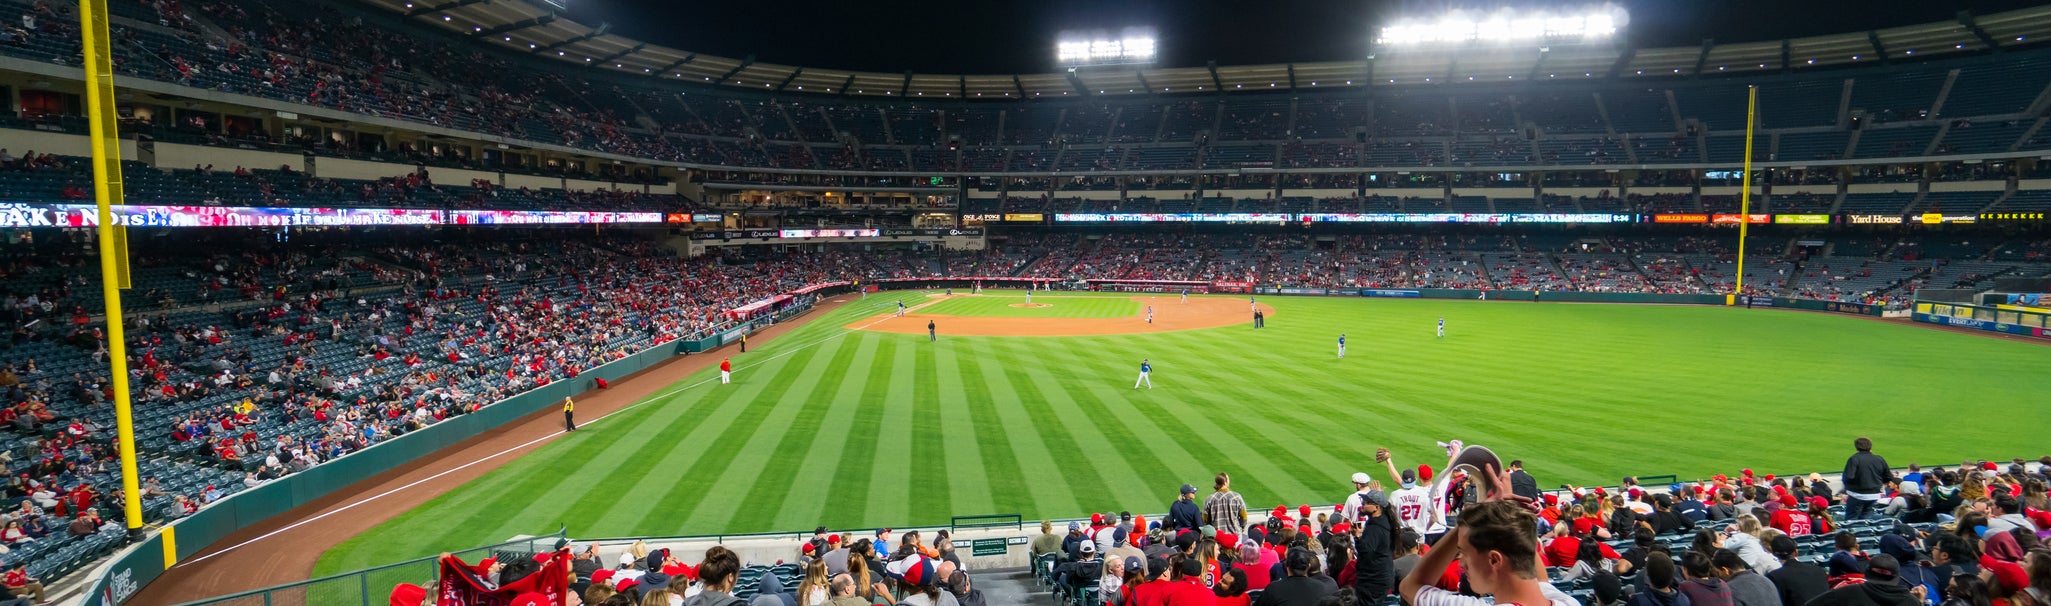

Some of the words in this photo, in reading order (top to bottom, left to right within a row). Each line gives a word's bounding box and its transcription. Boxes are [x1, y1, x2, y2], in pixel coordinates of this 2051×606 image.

[1850, 215, 1871, 224] Yard
[1872, 215, 1902, 224] House
[1400, 495, 1420, 503] TROUT
[1401, 504, 1421, 521] 27
